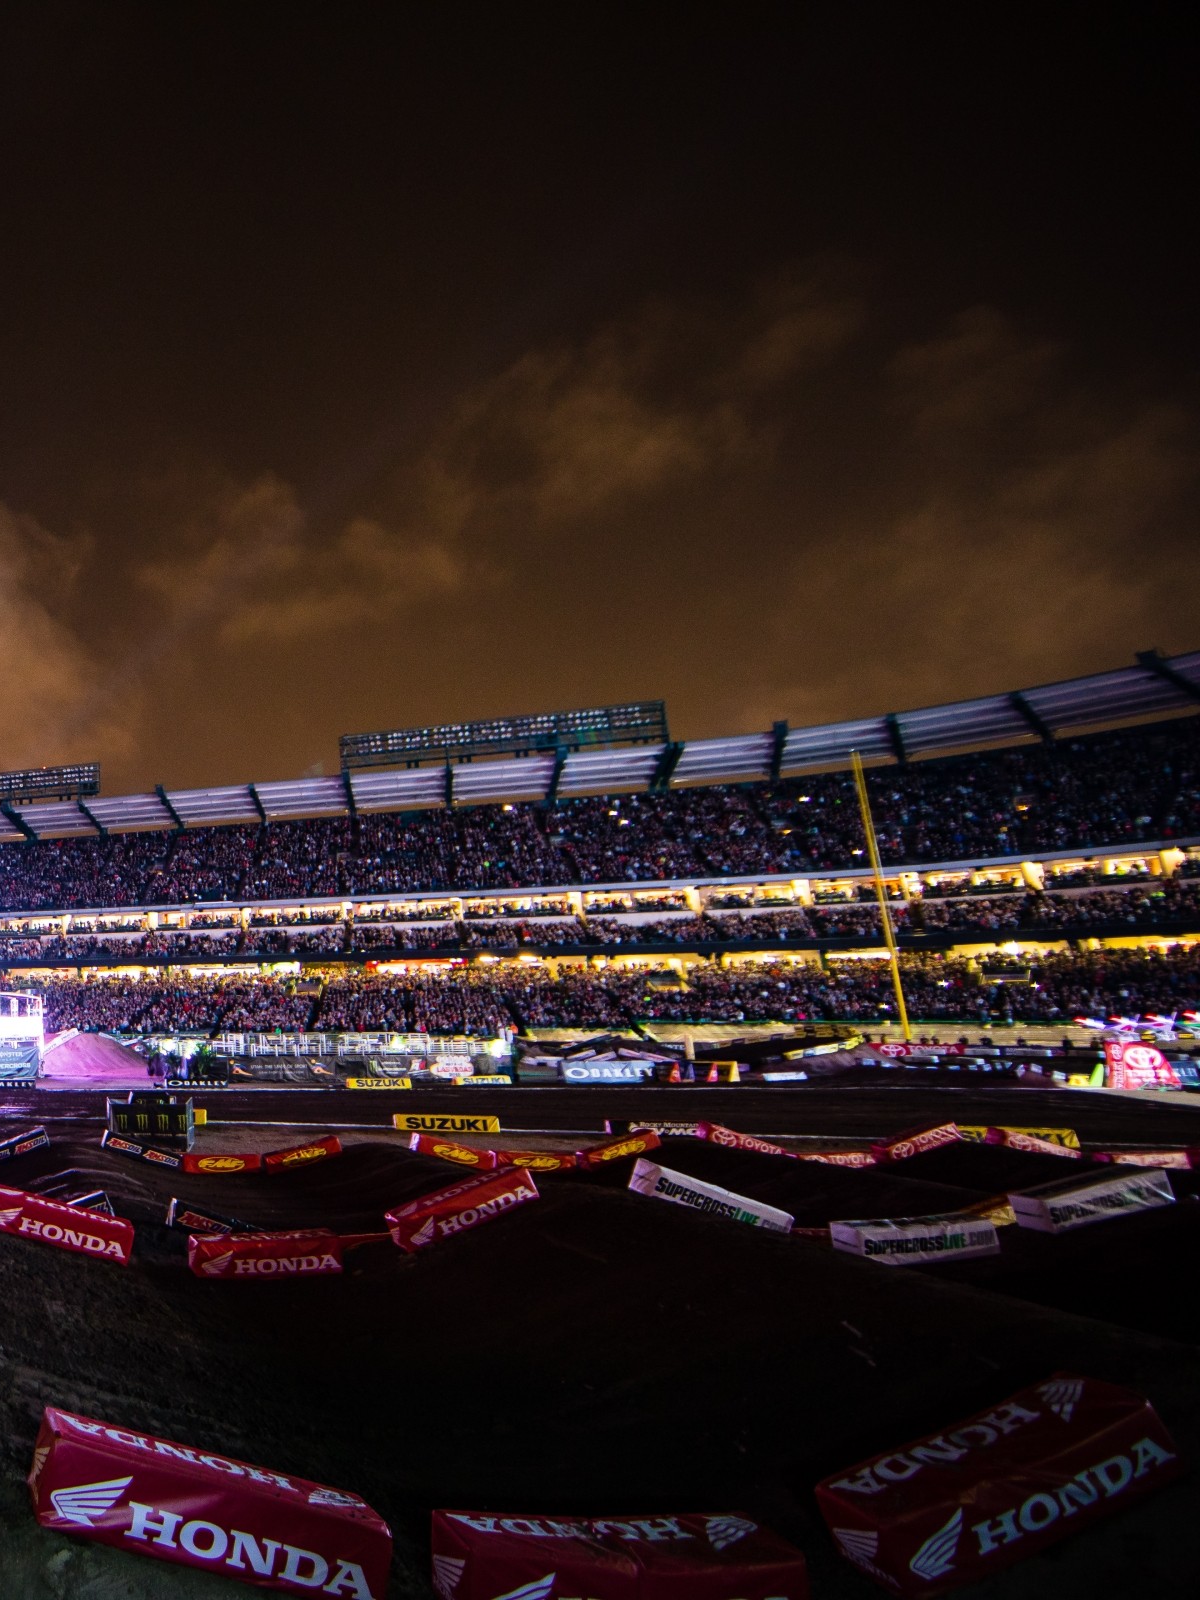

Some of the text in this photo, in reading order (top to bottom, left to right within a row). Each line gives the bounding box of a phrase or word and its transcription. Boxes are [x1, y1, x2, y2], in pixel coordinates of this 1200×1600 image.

[592, 1067, 653, 1078] OAKLEY
[355, 1078, 406, 1088] SUZUKI
[406, 1117, 489, 1131] SUZUKI
[639, 1121, 663, 1129] ROCKY
[15, 1134, 47, 1155] AMSOIL
[107, 1137, 143, 1155] AMSOIL
[738, 1136, 783, 1155] TOYOTA
[143, 1149, 180, 1166] AMSOIL
[199, 1157, 245, 1170] FMF
[512, 1156, 562, 1171] FMF
[828, 1153, 876, 1165] TOYOTA
[24, 1196, 128, 1229] HONDA
[436, 1185, 536, 1237] HONDA
[18, 1216, 126, 1260] HONDA
[234, 1254, 342, 1275] HONDA
[54, 1410, 300, 1493] HONDA
[828, 1401, 1042, 1495] HONDA
[970, 1436, 1178, 1557] HONDA
[445, 1511, 697, 1542] HONDA
[123, 1500, 378, 1600] HONDA
